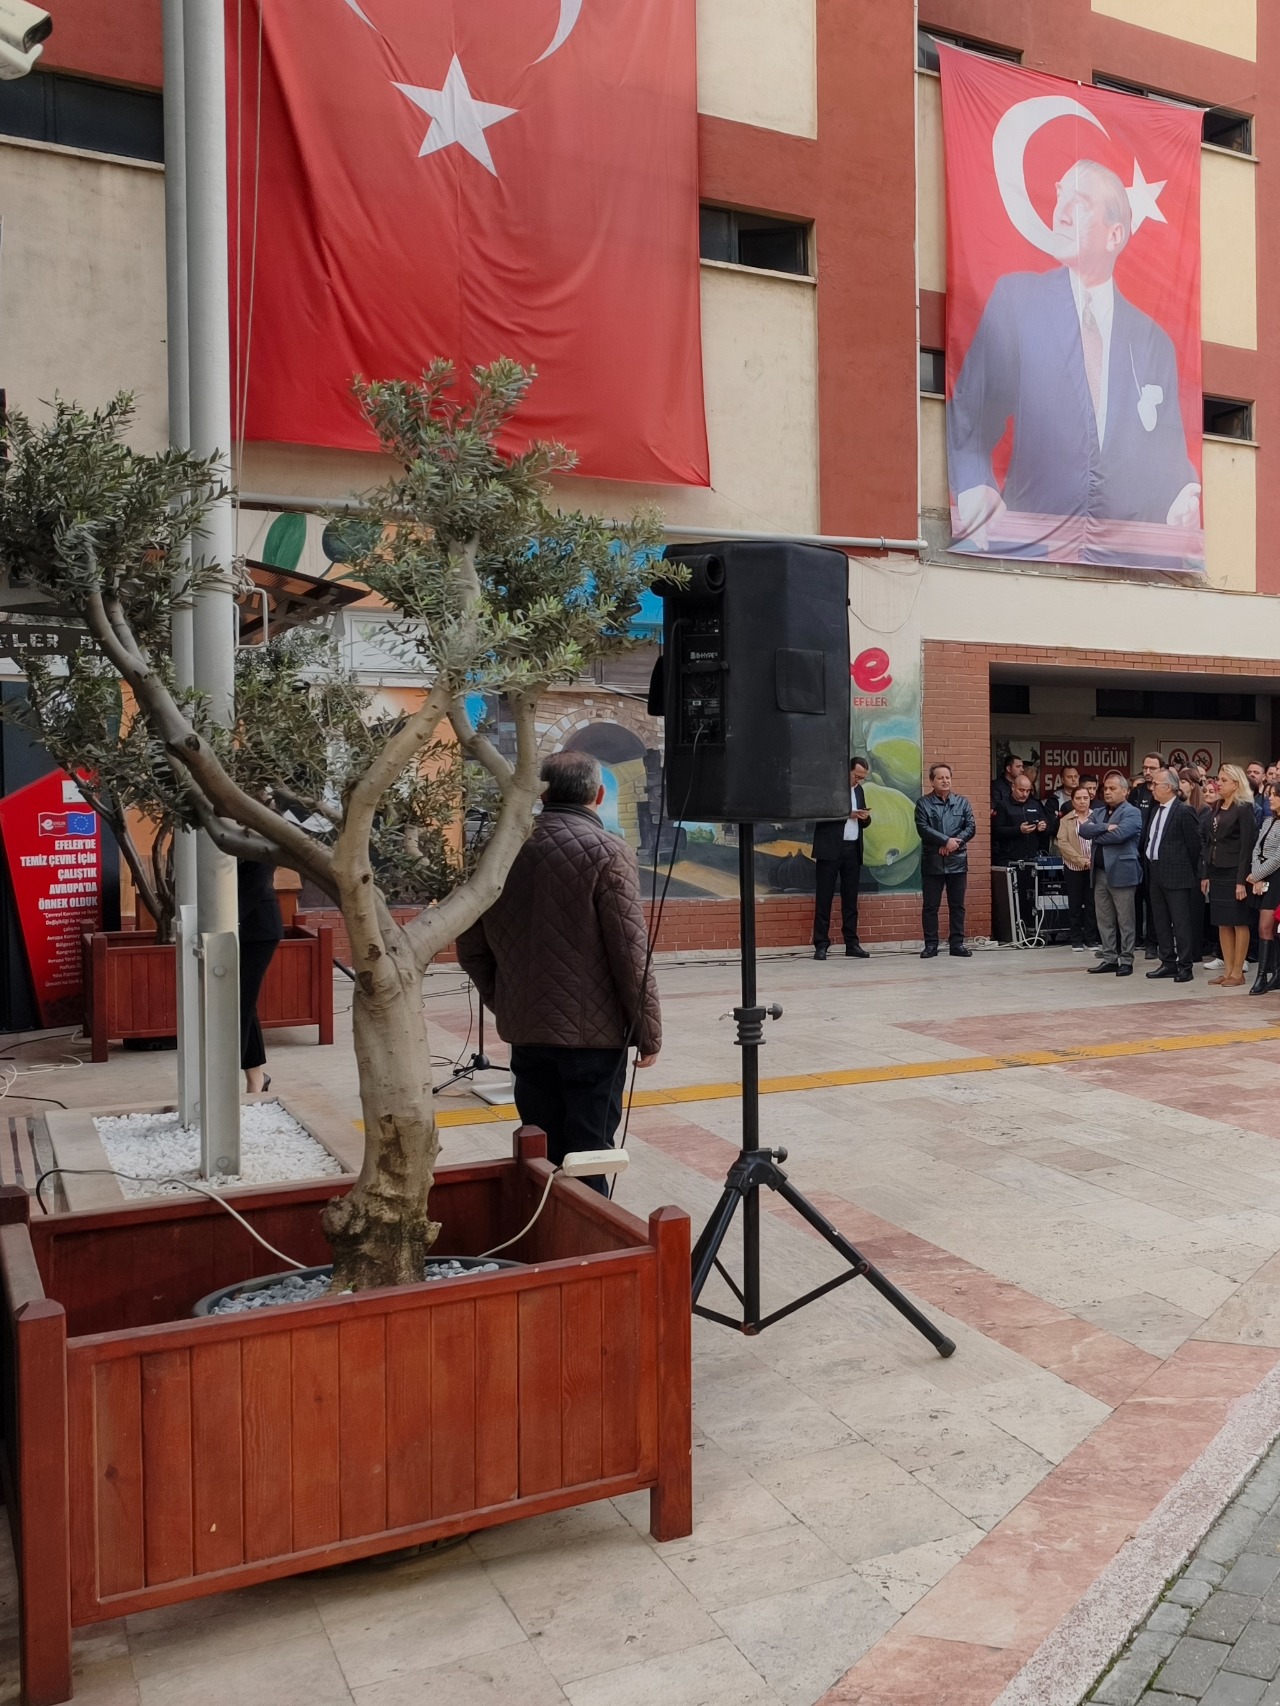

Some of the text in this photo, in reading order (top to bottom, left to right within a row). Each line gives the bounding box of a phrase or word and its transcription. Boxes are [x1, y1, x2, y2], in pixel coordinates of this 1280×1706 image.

[853, 697, 888, 707] EFELER
[1044, 746, 1128, 768] ESKO DÜĞÜN
[54, 839, 96, 850] EFELER'DE
[20, 852, 96, 867] TEMİZ ÇEVRE İÇİN
[57, 867, 97, 881] ÇALIŞTIK
[49, 882, 97, 895] AVRUPA'DA
[38, 896, 97, 910] ÖRNEK OLDUK
